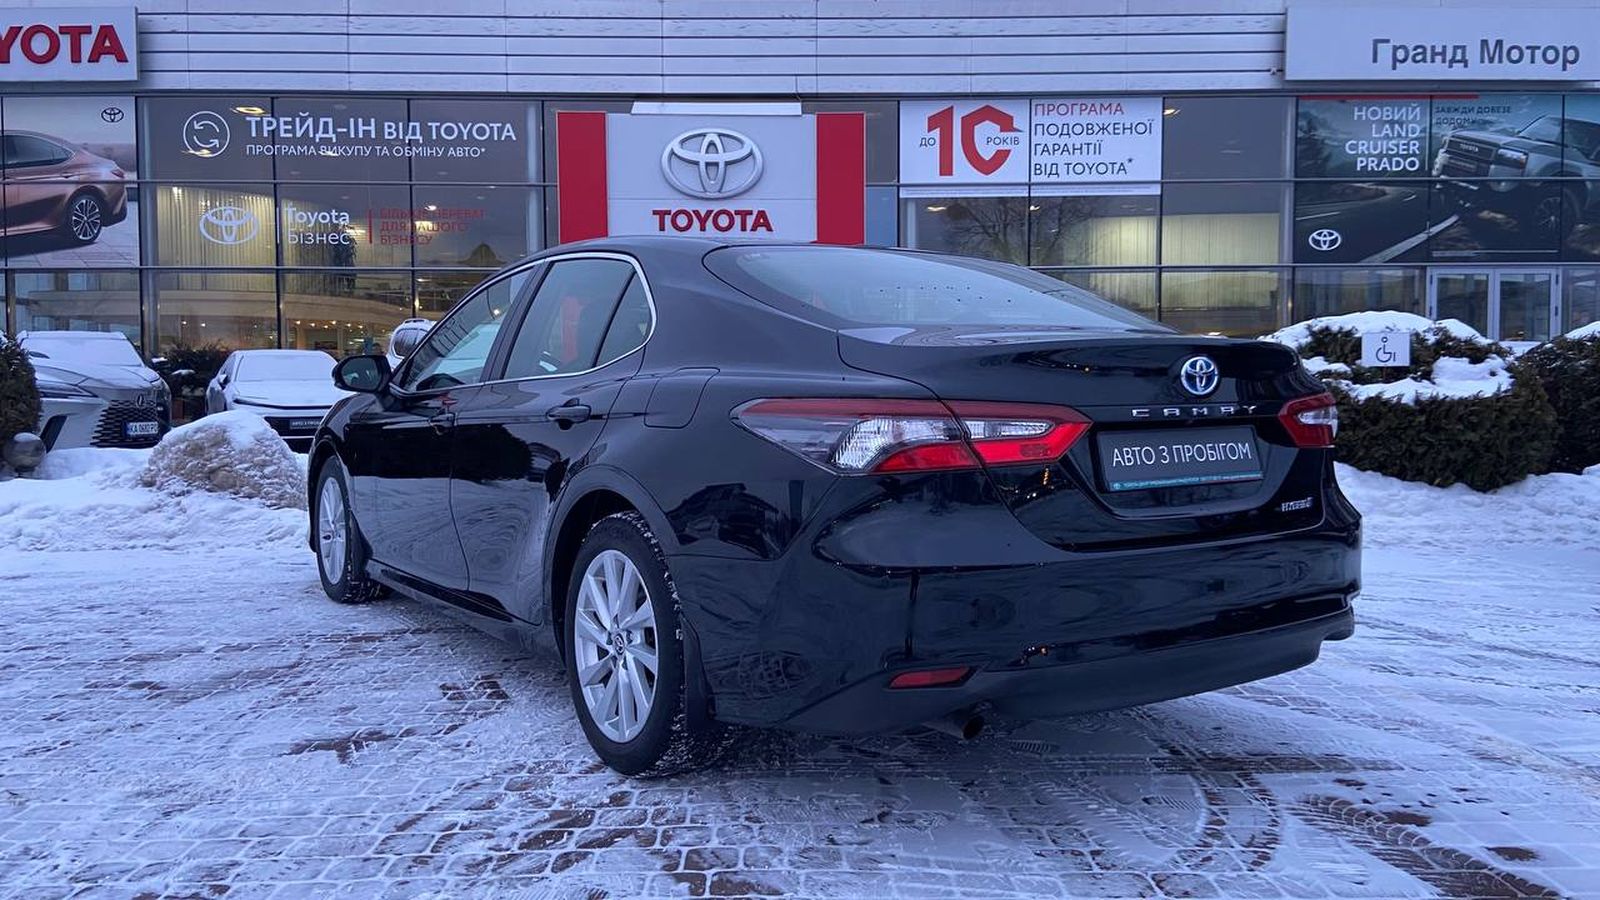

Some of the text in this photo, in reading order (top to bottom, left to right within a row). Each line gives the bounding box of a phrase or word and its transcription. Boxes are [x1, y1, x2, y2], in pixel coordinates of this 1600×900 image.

[1371, 38, 1580, 72] Гранд Мотор
[1034, 103, 1125, 116] ПРОГРАМА
[1354, 102, 1421, 121] НОВИЙ
[245, 111, 517, 144] ТРЕЙД-ІН ВІД TOYOTA
[1034, 118, 1155, 138] ПОДОВЖЕНОЇ
[1371, 123, 1421, 138] LAND
[919, 136, 936, 147] ДО
[986, 136, 1020, 146] РОКІВ
[1034, 139, 1103, 156] ГАРАНТІЇ
[1345, 140, 1420, 155] CRUISER
[246, 144, 317, 156] ПРОГРАМА
[319, 145, 372, 157] ВИКУПУ
[374, 145, 390, 157] ТА
[392, 145, 445, 157] ОБМІНУ
[1034, 162, 1060, 178] ВІД
[1356, 157, 1420, 172] PRADO
[284, 204, 350, 228] Toyota
[652, 208, 774, 233] TOYOTA
[287, 229, 351, 245] Бізнес
[1131, 405, 1257, 417] CAMRY
[1112, 446, 1156, 467] АВТО
[1172, 442, 1252, 463] ПРОБІГОМ
